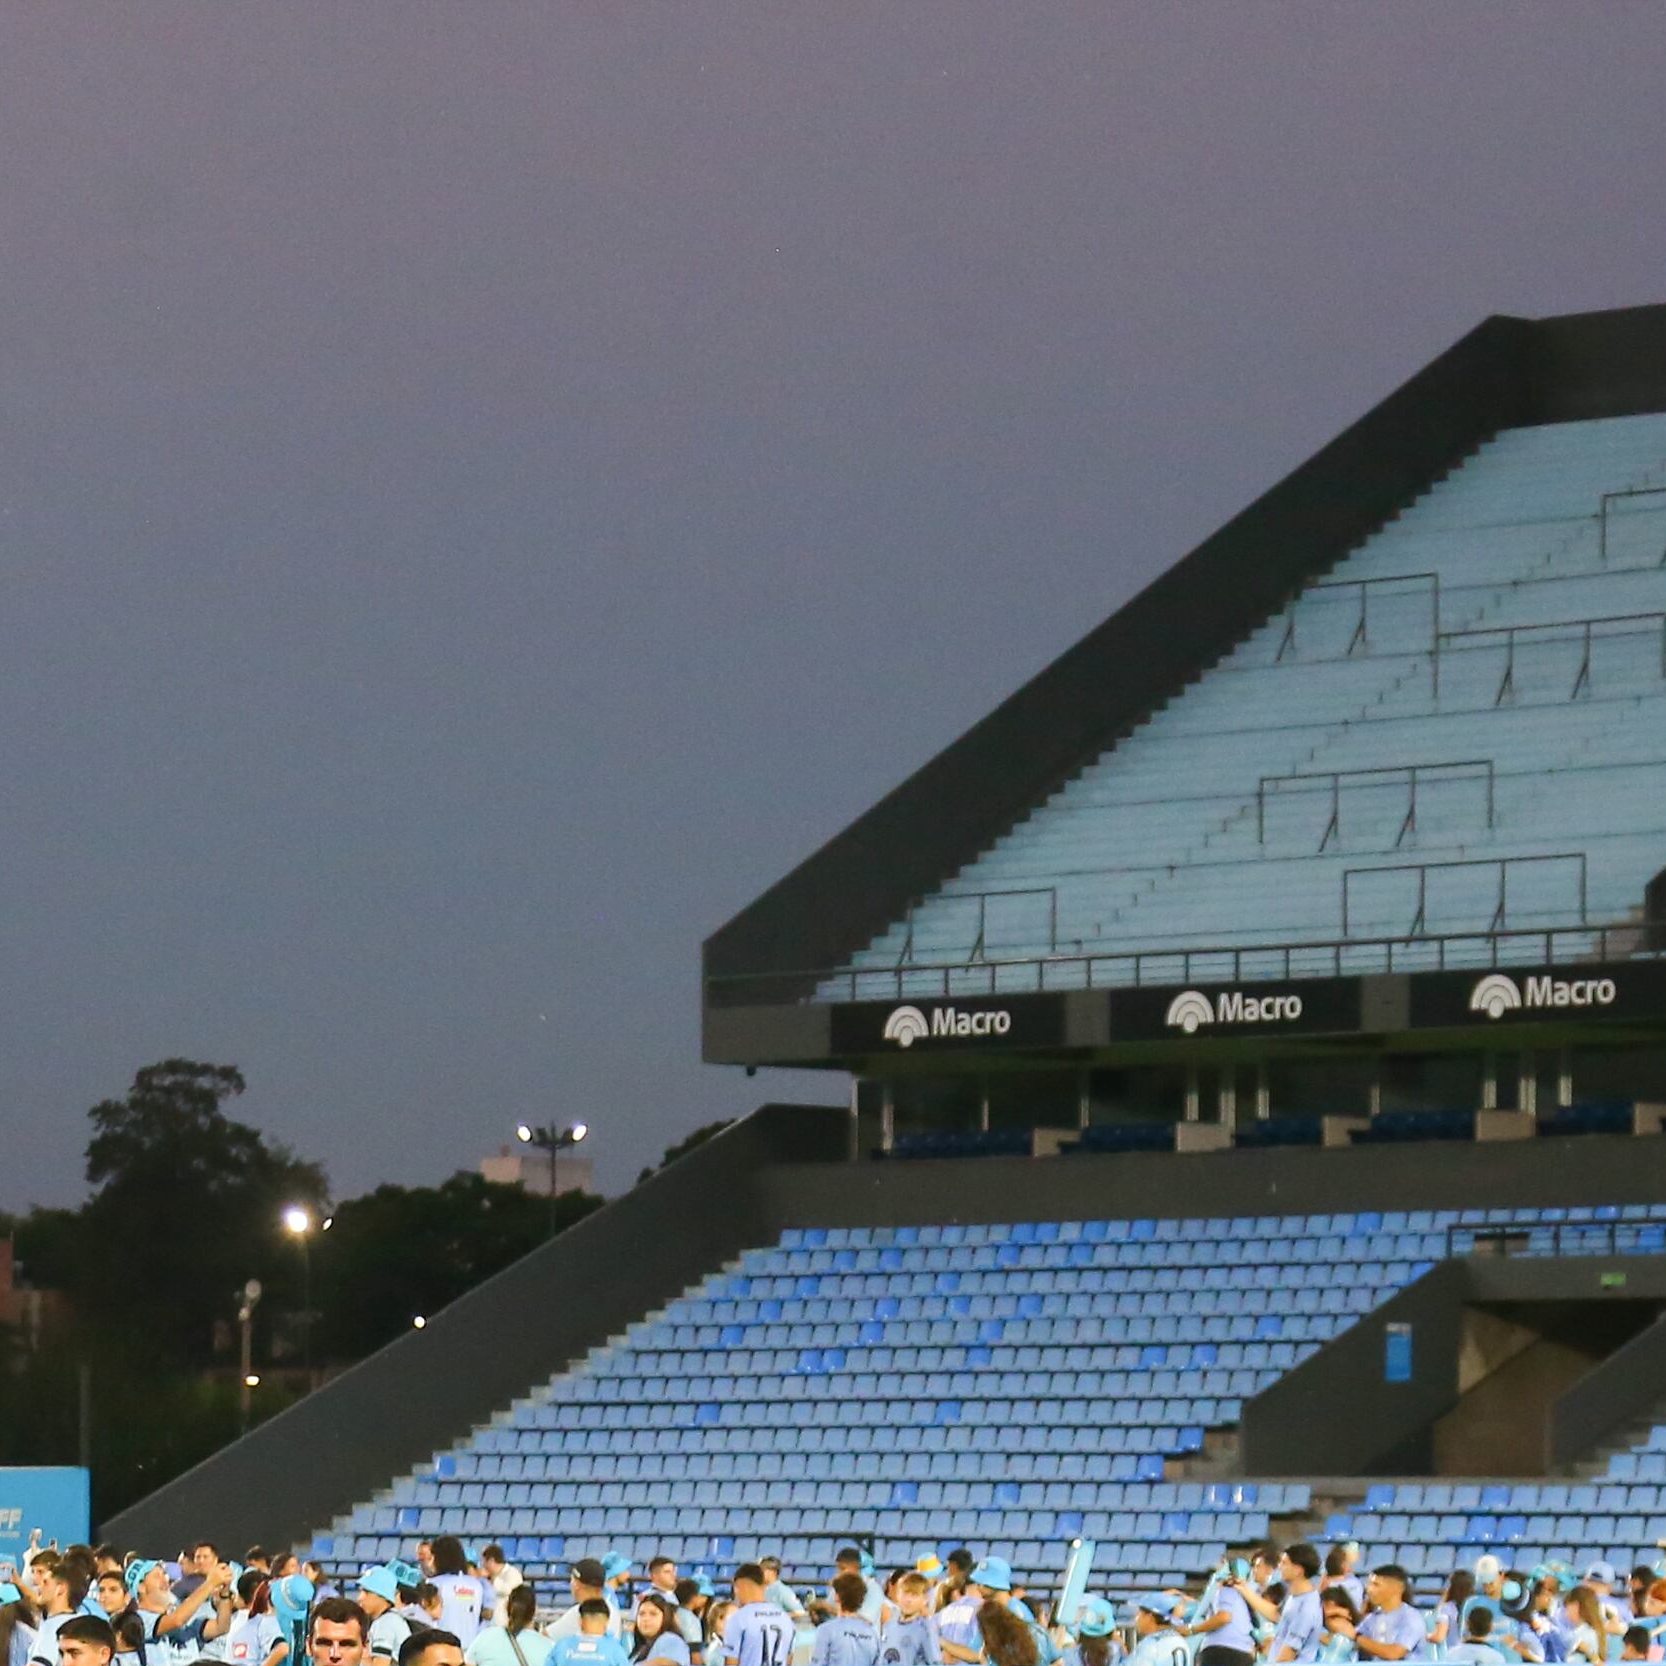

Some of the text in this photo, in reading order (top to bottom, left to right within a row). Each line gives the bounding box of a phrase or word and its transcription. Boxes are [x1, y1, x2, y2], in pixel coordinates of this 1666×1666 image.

[1526, 975, 1616, 1007] Macro
[932, 1007, 1011, 1036] Macro
[1219, 992, 1302, 1022] Macro
